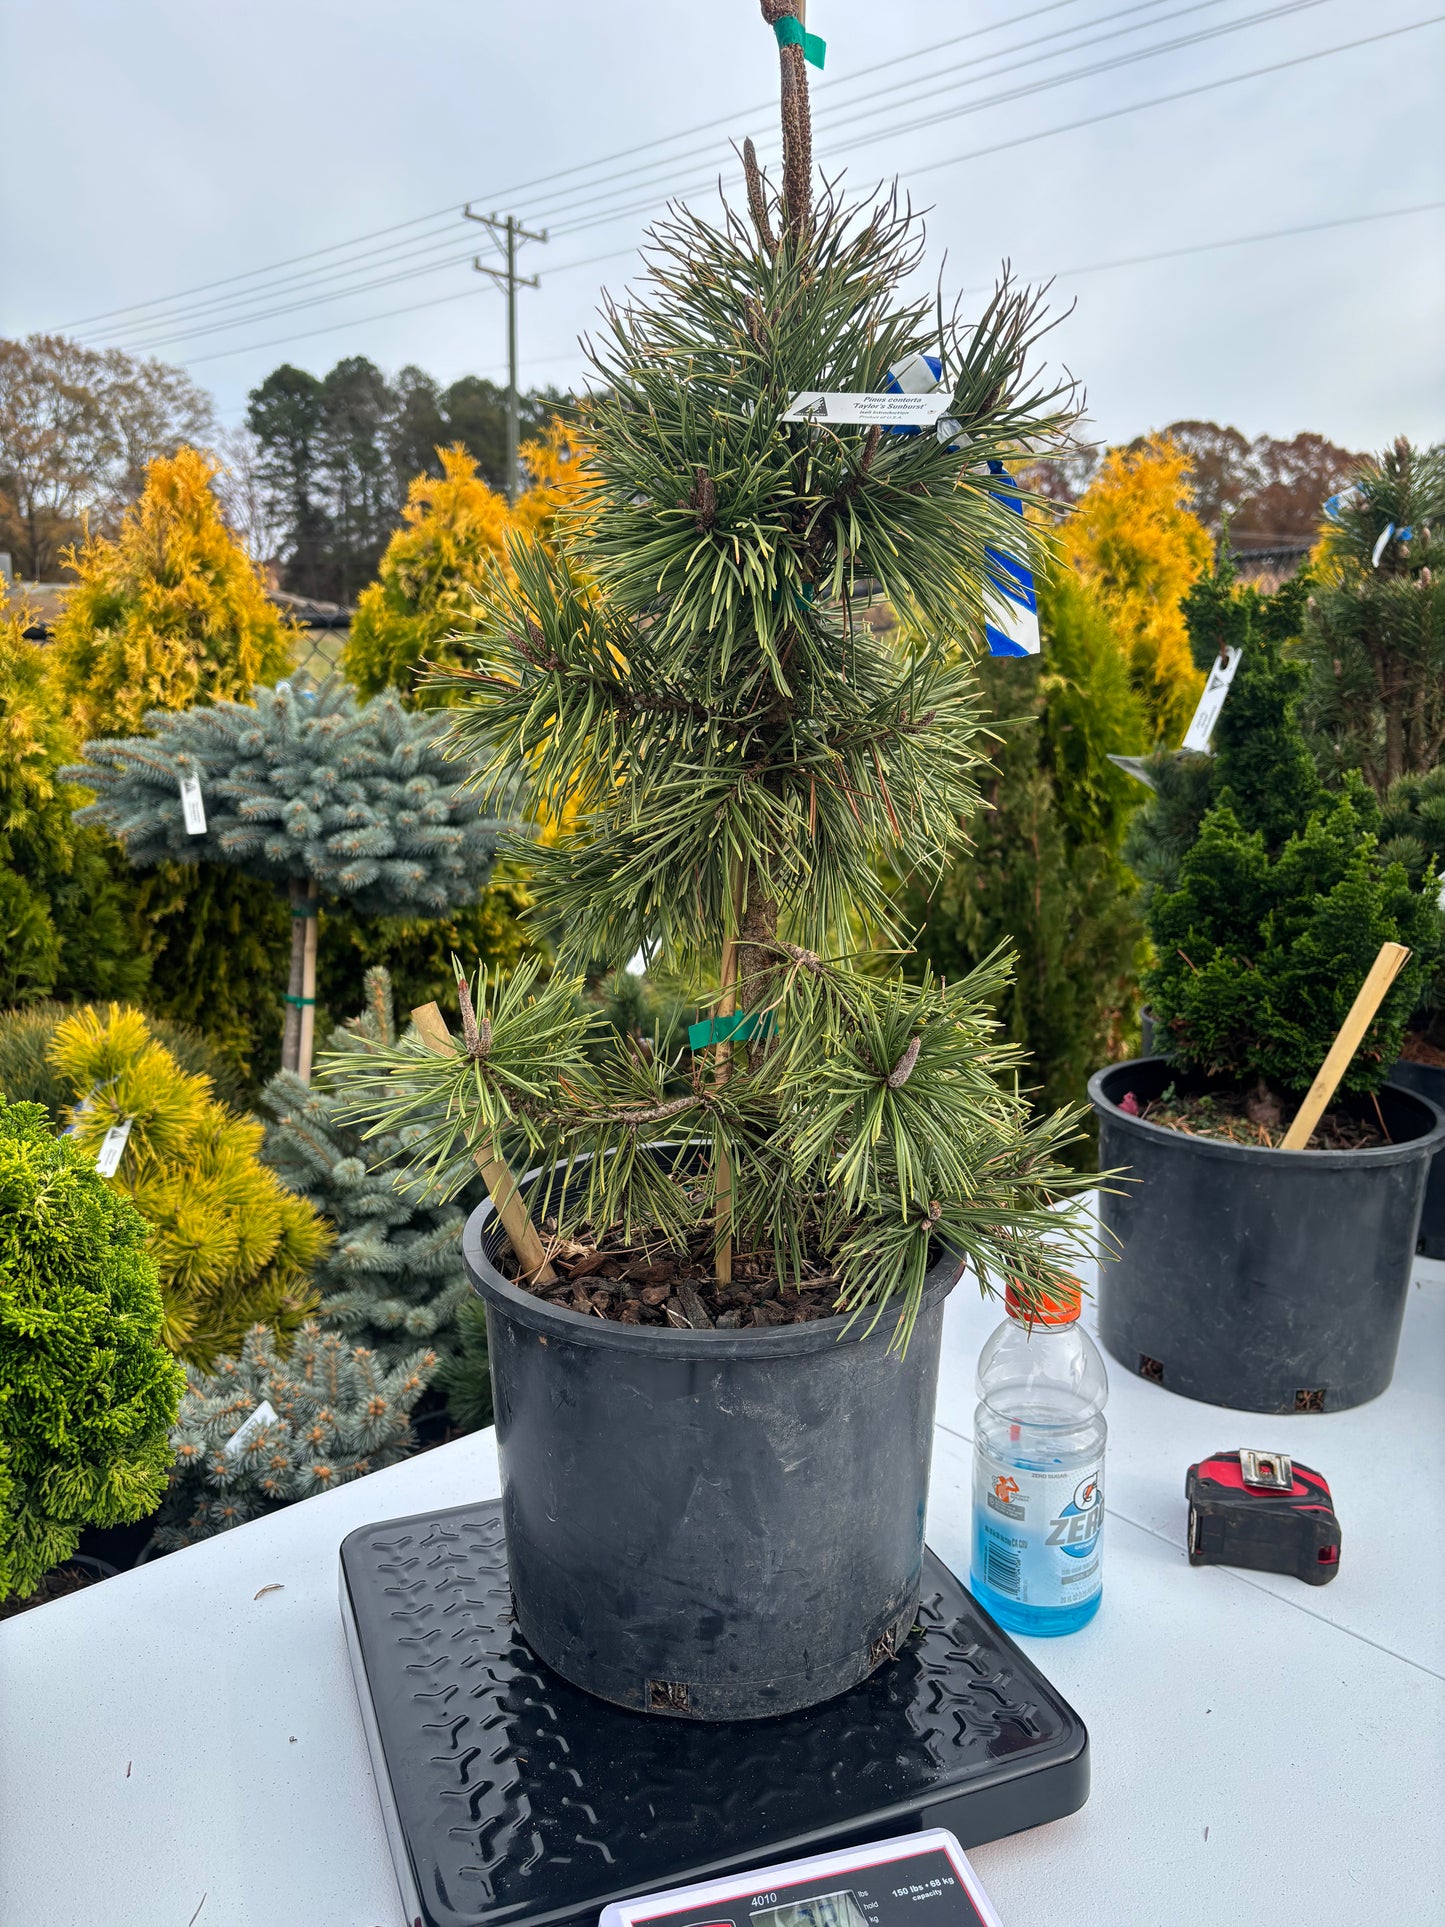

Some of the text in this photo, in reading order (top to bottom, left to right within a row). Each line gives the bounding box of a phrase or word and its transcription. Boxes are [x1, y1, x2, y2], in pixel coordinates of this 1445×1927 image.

[892, 1876, 955, 1897] 150 lbs 68 kg
[857, 1890, 869, 1898] lbs
[912, 1889, 943, 1901] capacity
[751, 1892, 777, 1907] 4010
[863, 1901, 879, 1910] hold
[869, 1915, 879, 1923] kg
